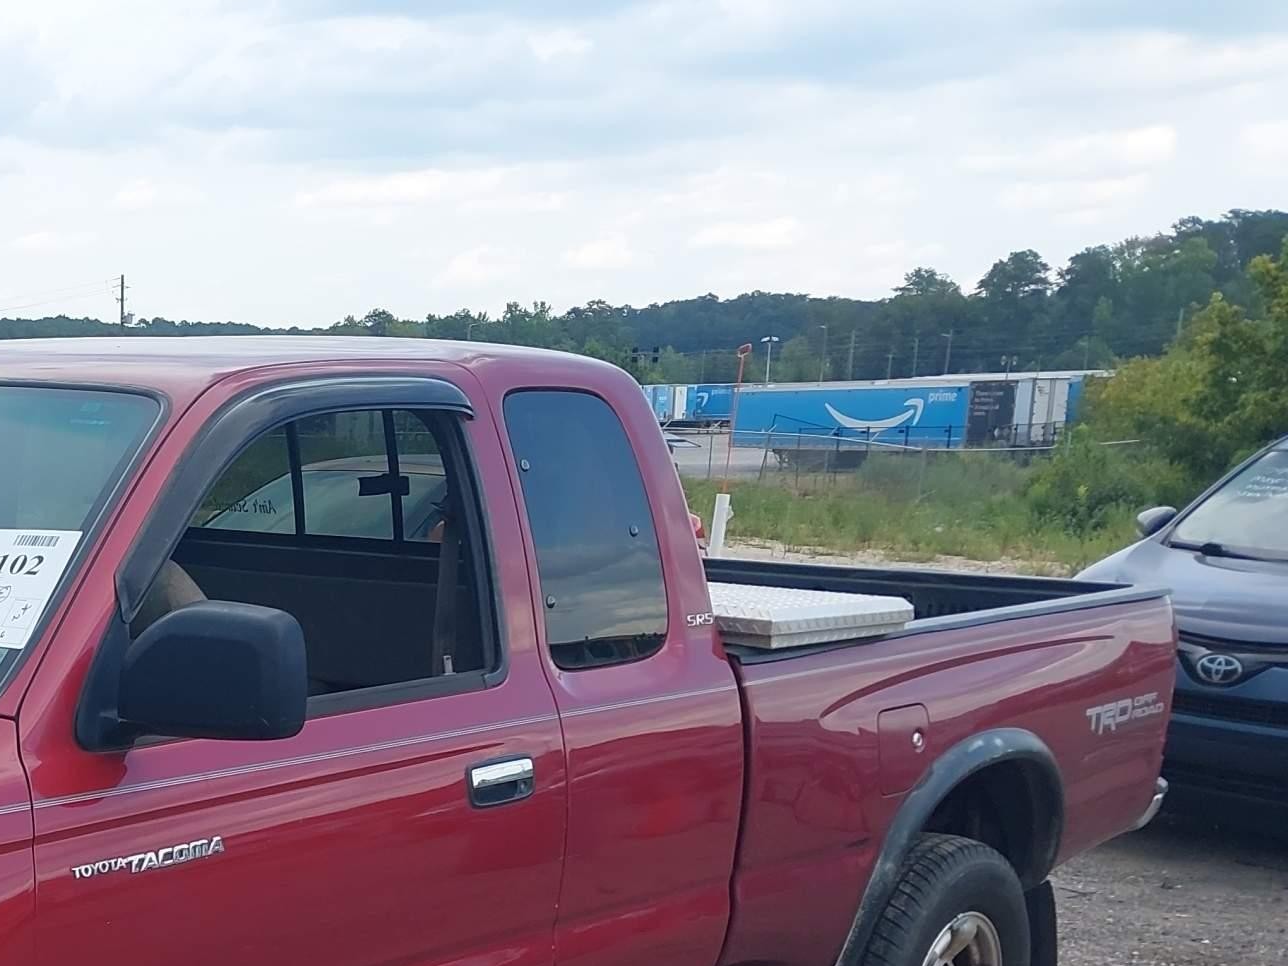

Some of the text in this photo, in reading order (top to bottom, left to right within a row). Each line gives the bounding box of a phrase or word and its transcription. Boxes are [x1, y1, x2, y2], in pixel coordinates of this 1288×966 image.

[928, 389, 958, 404] prime
[1086, 698, 1132, 735] TRD
[1132, 702, 1165, 719] ROAD
[72, 836, 225, 879] TOYOTA TACOMA
